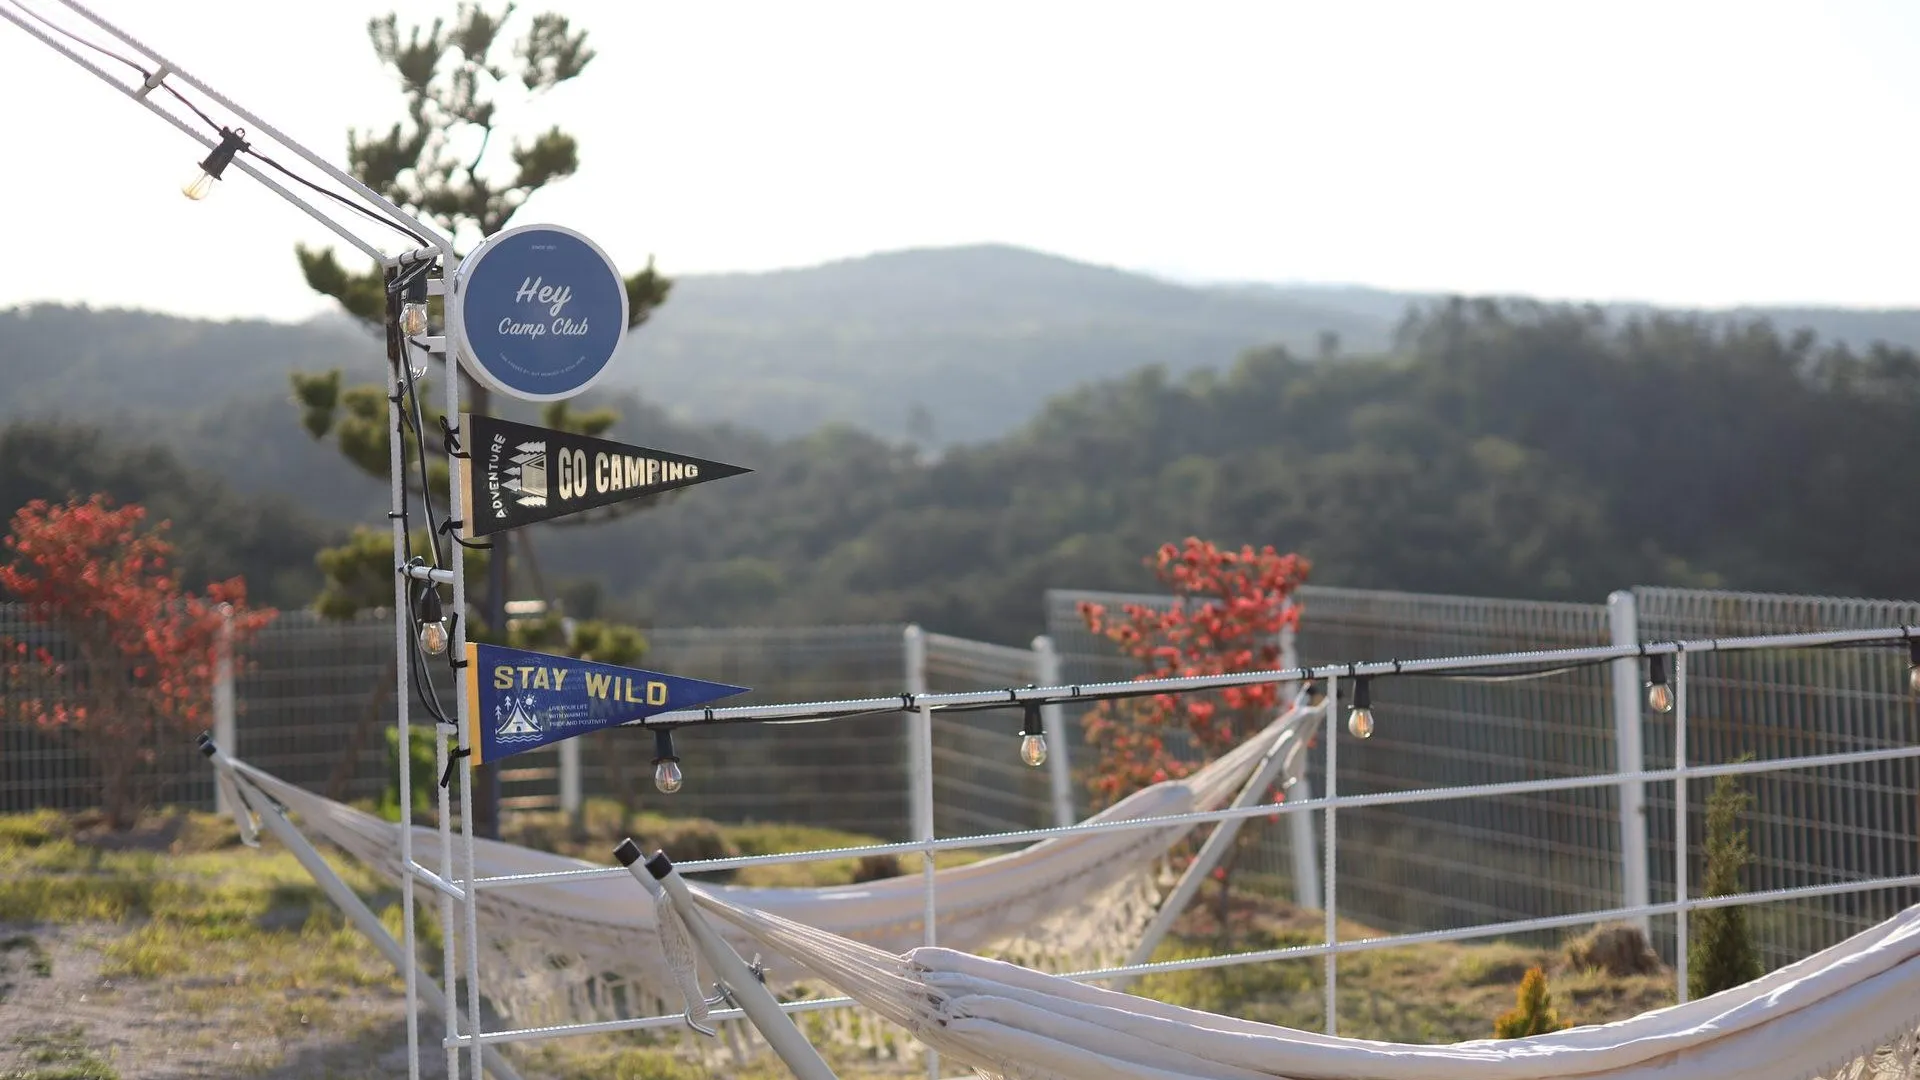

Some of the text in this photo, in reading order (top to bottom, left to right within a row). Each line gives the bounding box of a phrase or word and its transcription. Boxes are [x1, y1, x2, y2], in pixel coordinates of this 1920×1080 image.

[515, 276, 572, 317] Hey
[498, 317, 589, 340] Camp Club
[487, 433, 507, 519] ADVENTURE
[558, 446, 699, 500] GO CAMPING
[493, 665, 668, 707] STAY WILD
